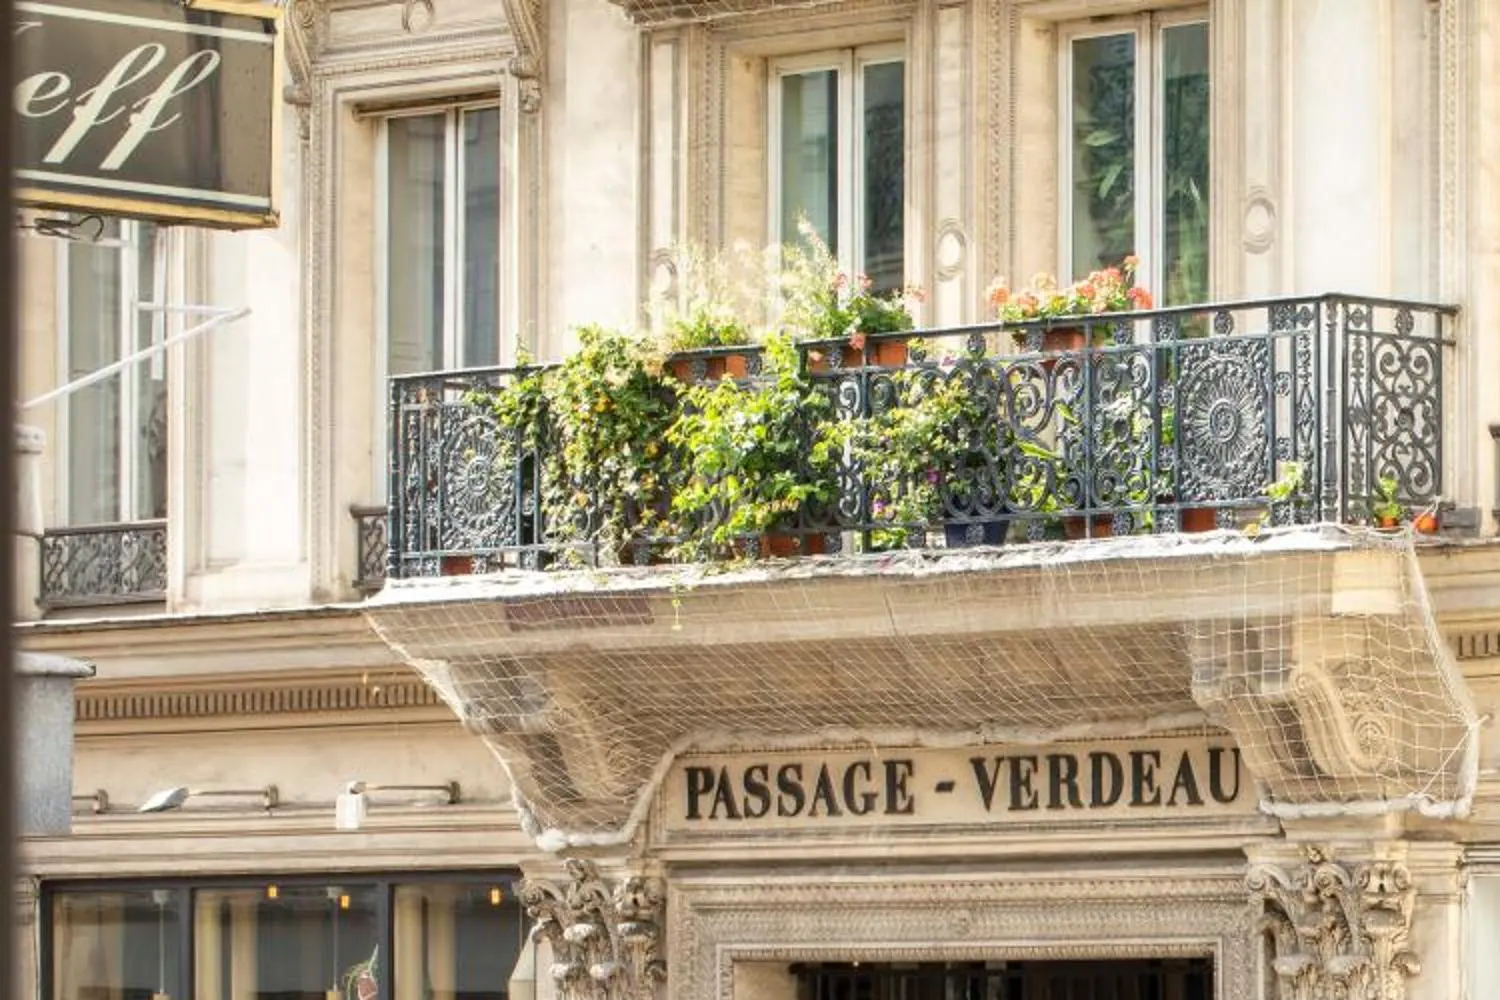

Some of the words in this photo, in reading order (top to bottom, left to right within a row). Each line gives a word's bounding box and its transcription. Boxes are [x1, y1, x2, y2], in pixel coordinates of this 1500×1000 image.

[14, 21, 221, 170] eff
[684, 758, 915, 821] PASSAGE
[970, 747, 1241, 813] VERDEAU
